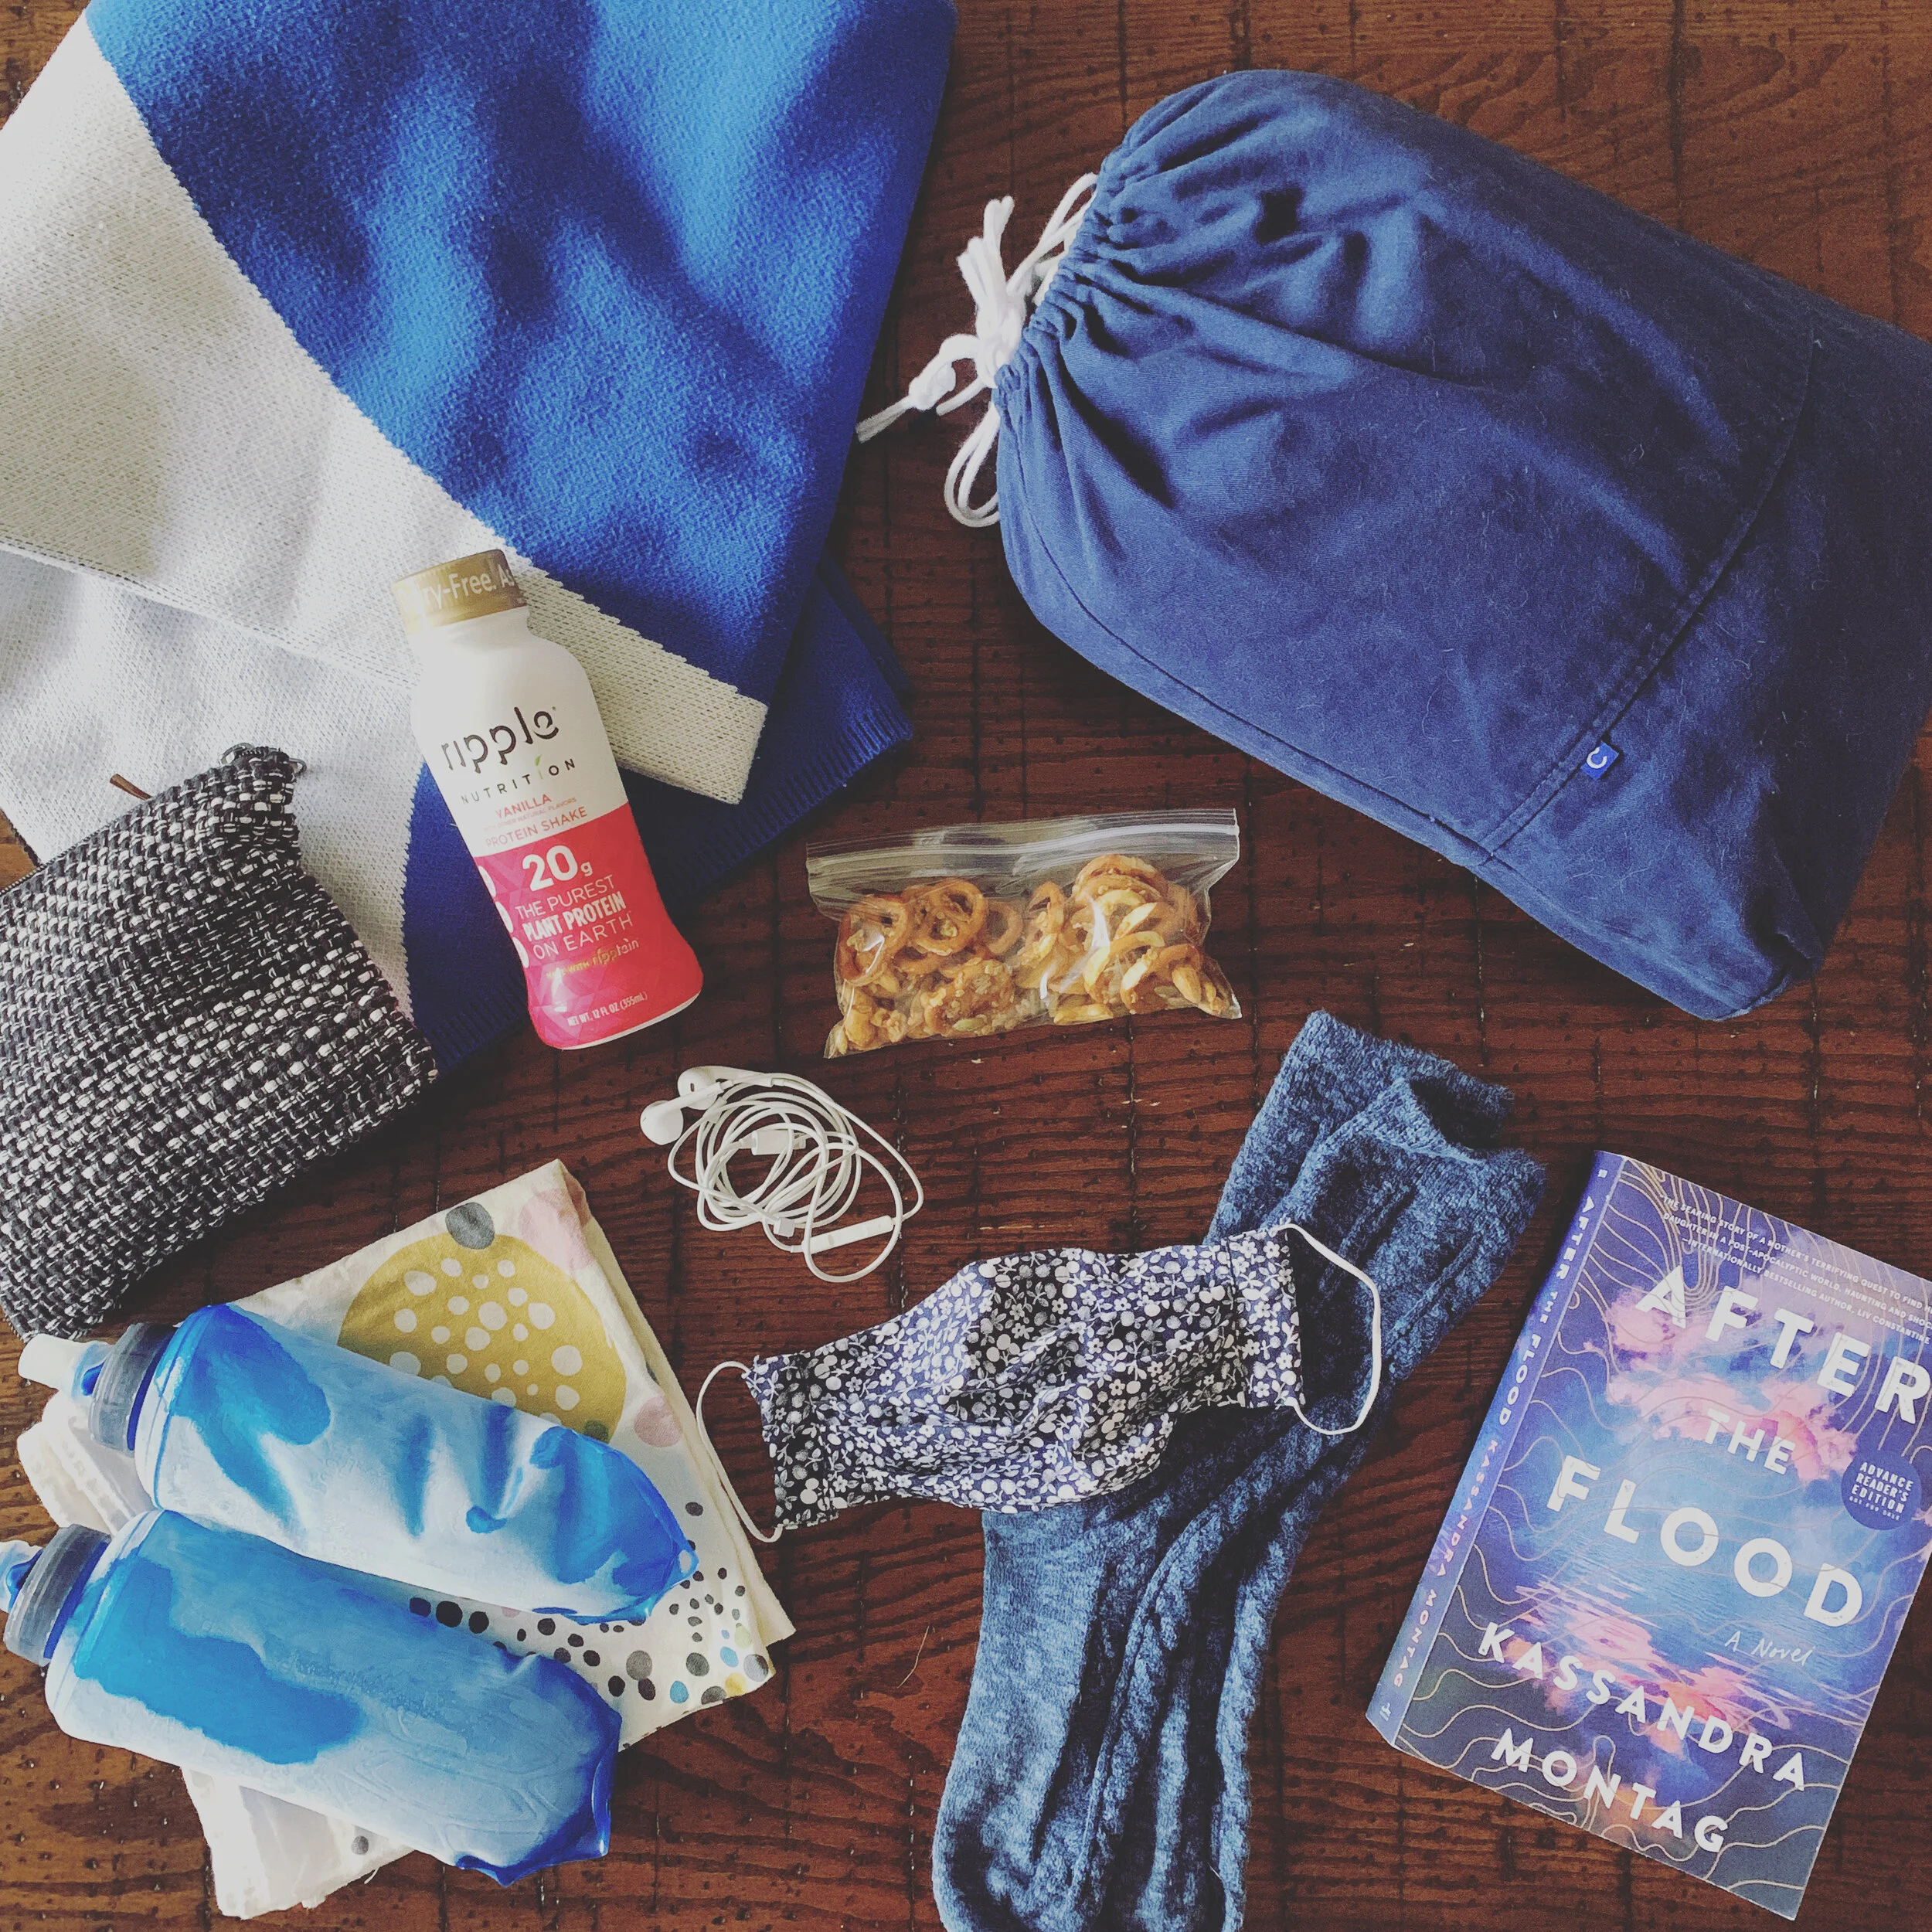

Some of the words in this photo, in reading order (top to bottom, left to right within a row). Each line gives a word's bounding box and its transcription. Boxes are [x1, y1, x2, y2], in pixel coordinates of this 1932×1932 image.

[441, 706, 560, 774] ripple
[461, 754, 576, 804] NUTRITION
[495, 793, 552, 819] VANILLA
[547, 796, 577, 811] FLAVORS
[485, 825, 539, 848] PROTEIN
[542, 806, 588, 832] SHAKE
[515, 900, 546, 920] THE
[546, 874, 615, 912] PUREST
[522, 914, 563, 942] PLANT
[563, 891, 627, 930] PROTEIN
[533, 940, 560, 960] ON
[563, 913, 634, 952] EARTH
[592, 1009, 600, 1019] 12
[609, 1002, 620, 1013] OZ
[1556, 1196, 1595, 1280] AFTER
[1663, 1213, 1709, 1236] DAUGHTER
[1709, 1231, 1719, 1240] IN
[1728, 1239, 1808, 1277] POST-APOCALYPTIC
[1845, 1287, 1887, 1311] HAUNTING
[1888, 1306, 1906, 1318] AND
[1908, 1314, 1932, 1330] SHOC
[1680, 1204, 1717, 1223] SEARING
[1718, 1219, 1746, 1236] STORY
[1747, 1231, 1759, 1240] OF
[1811, 1257, 1859, 1283] TERRIFYING
[1861, 1279, 1888, 1294] QUEST
[1889, 1290, 1901, 1300] TO
[1902, 1296, 1923, 1309] FIND
[1539, 1291, 1558, 1324] THE
[1764, 1270, 1818, 1298] BESTSELLING
[1856, 1308, 1872, 1320] LIV
[1872, 1315, 1930, 1345] CONSTANTINE
[1634, 1265, 1932, 1424] AFTER
[1499, 1334, 1542, 1426] FLOOD
[1703, 1408, 1796, 1475] THE
[1437, 1440, 1498, 1577] KASSANDRA
[1851, 1484, 1904, 1513] EDITION
[1859, 1461, 1913, 1491] ADVANCE
[1547, 1455, 1863, 1627] FLOOD
[1393, 1589, 1437, 1688] MONTAG
[1724, 1631, 1740, 1652] A
[1750, 1638, 1816, 1666] Novel
[1478, 1622, 1805, 1791] KASSANDRA
[1491, 1727, 1730, 1853] MONTAG
